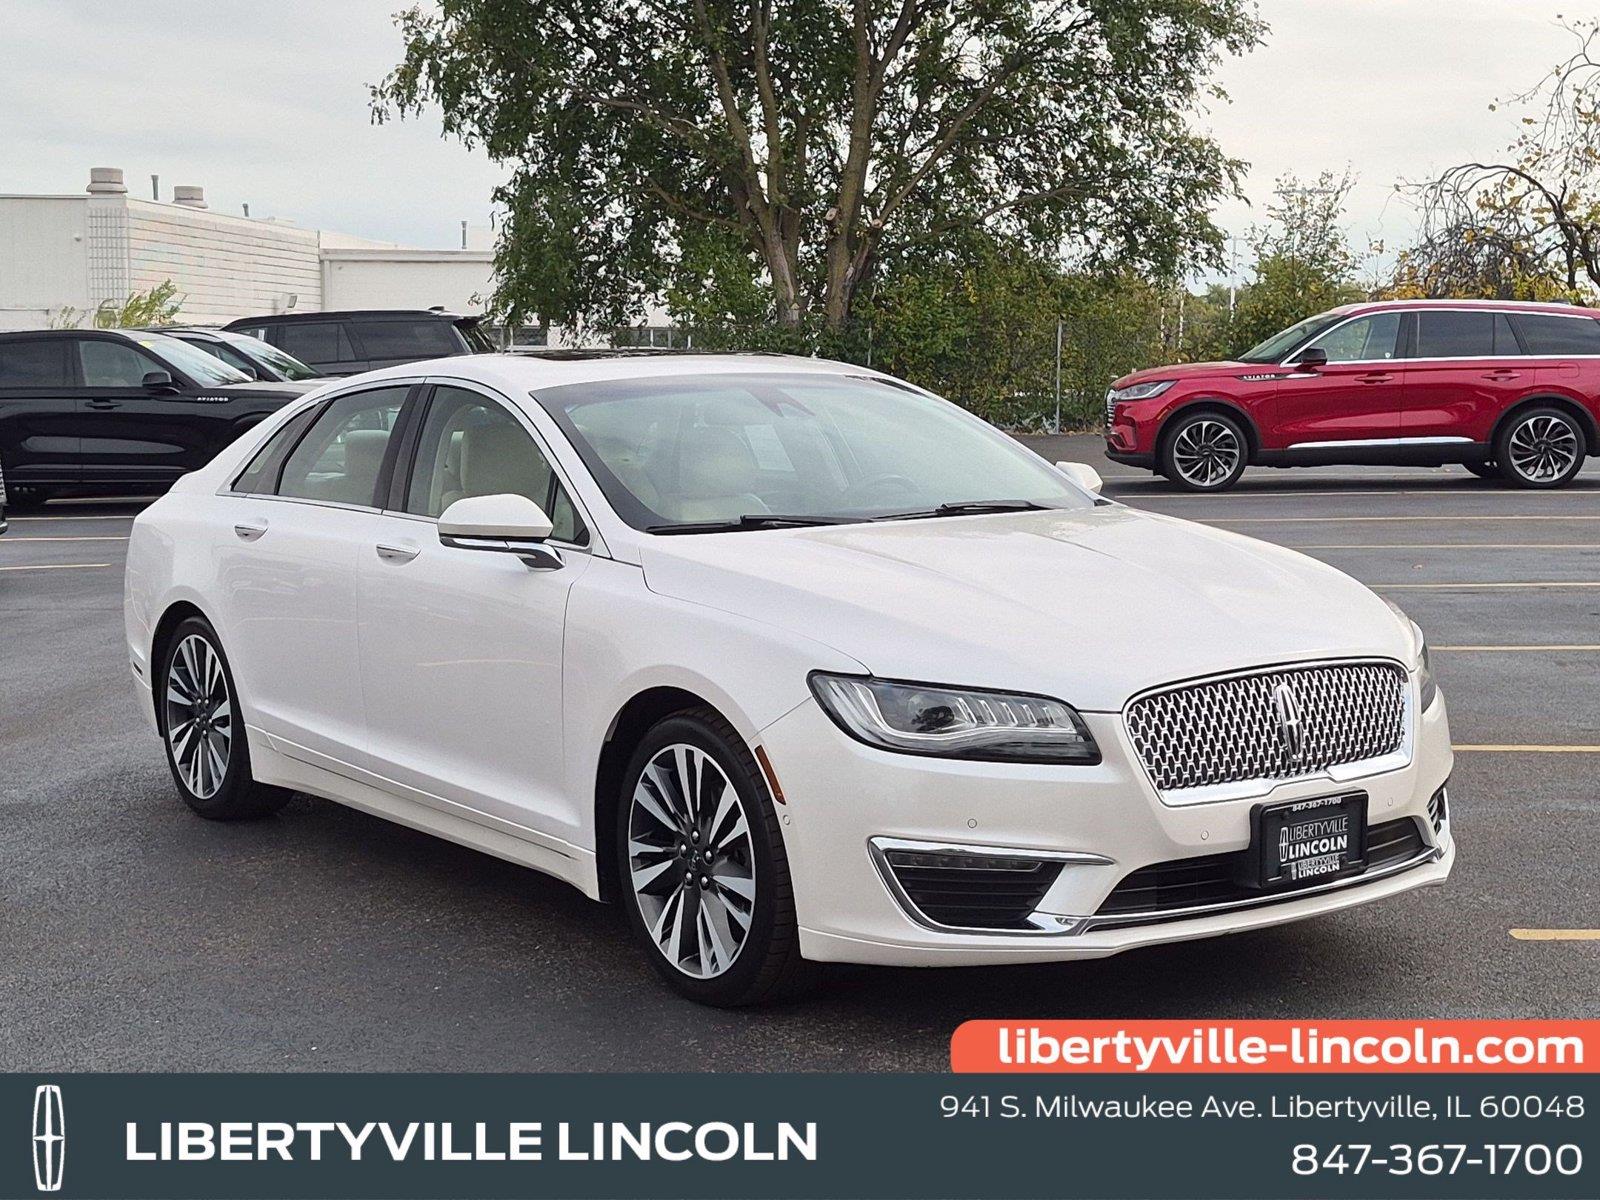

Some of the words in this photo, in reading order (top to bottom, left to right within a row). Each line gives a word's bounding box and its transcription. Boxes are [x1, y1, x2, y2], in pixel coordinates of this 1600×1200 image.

[1292, 796, 1341, 812] 847-367-1700
[1290, 816, 1349, 842] LIBERTYVILLE
[1289, 834, 1348, 860] LINCOLN
[1298, 854, 1340, 870] LIBERTYVILLE
[1298, 861, 1340, 879] LINCOLN
